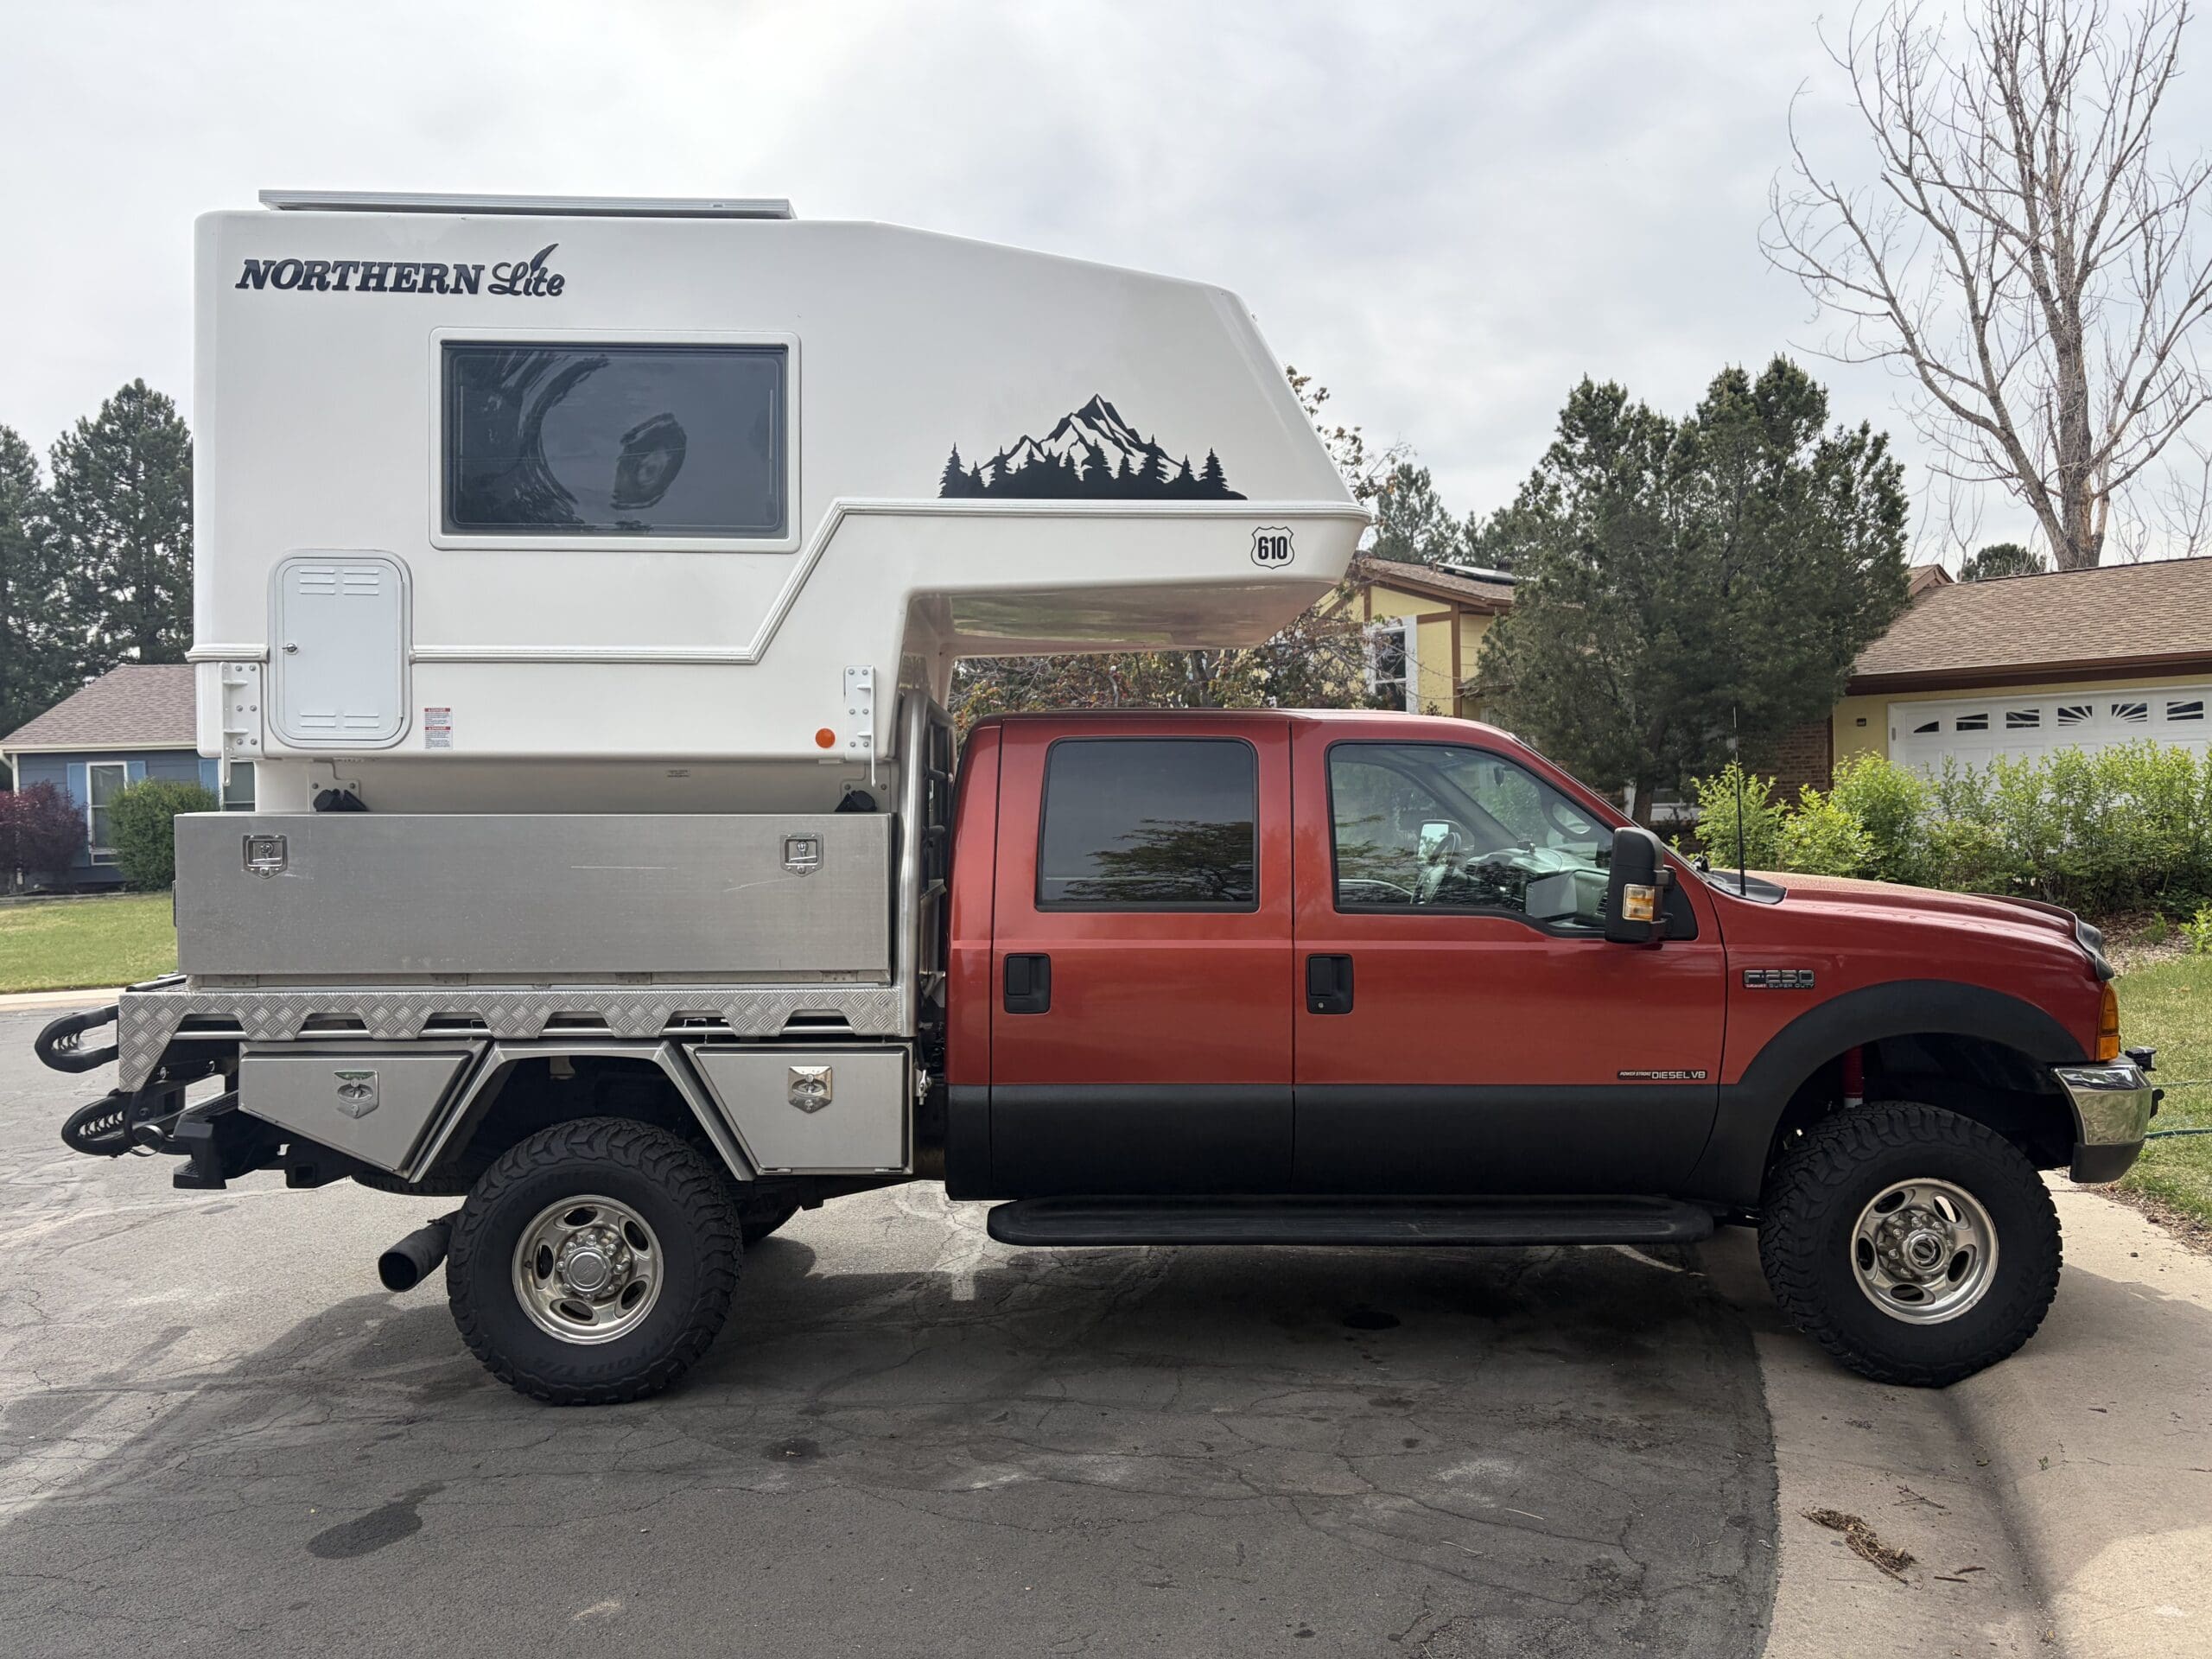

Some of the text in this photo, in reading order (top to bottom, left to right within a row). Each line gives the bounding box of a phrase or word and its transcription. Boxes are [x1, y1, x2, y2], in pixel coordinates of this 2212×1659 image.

[234, 243, 566, 297] NORTHERN Lite
[1257, 536, 1287, 560] 610
[1651, 1071, 1690, 1079] DIESEL
[1690, 1071, 1706, 1079] V8
